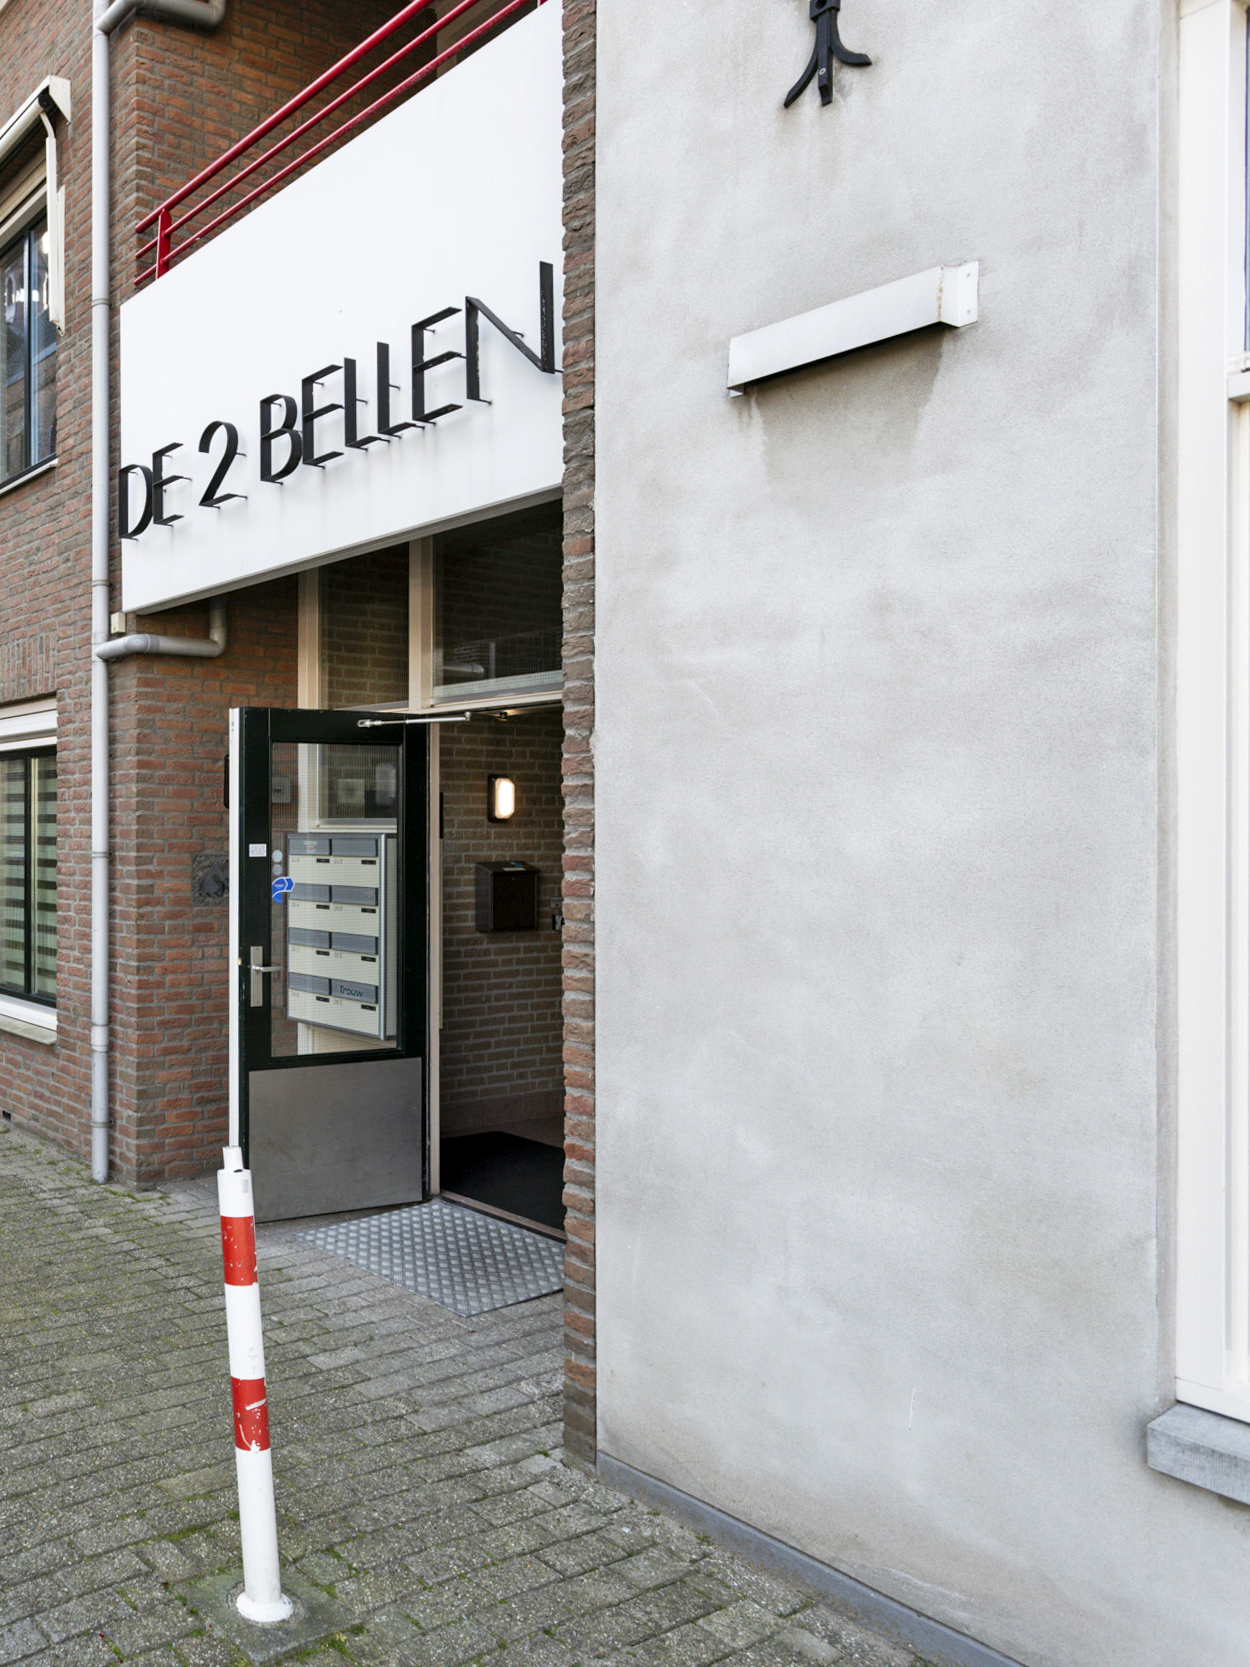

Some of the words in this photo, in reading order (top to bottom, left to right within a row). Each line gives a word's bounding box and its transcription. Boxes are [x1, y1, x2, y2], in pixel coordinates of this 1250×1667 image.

[119, 442, 186, 541] DE
[199, 420, 247, 508] 2
[260, 261, 555, 484] BELLEN
[339, 985, 364, 998] Trouw
